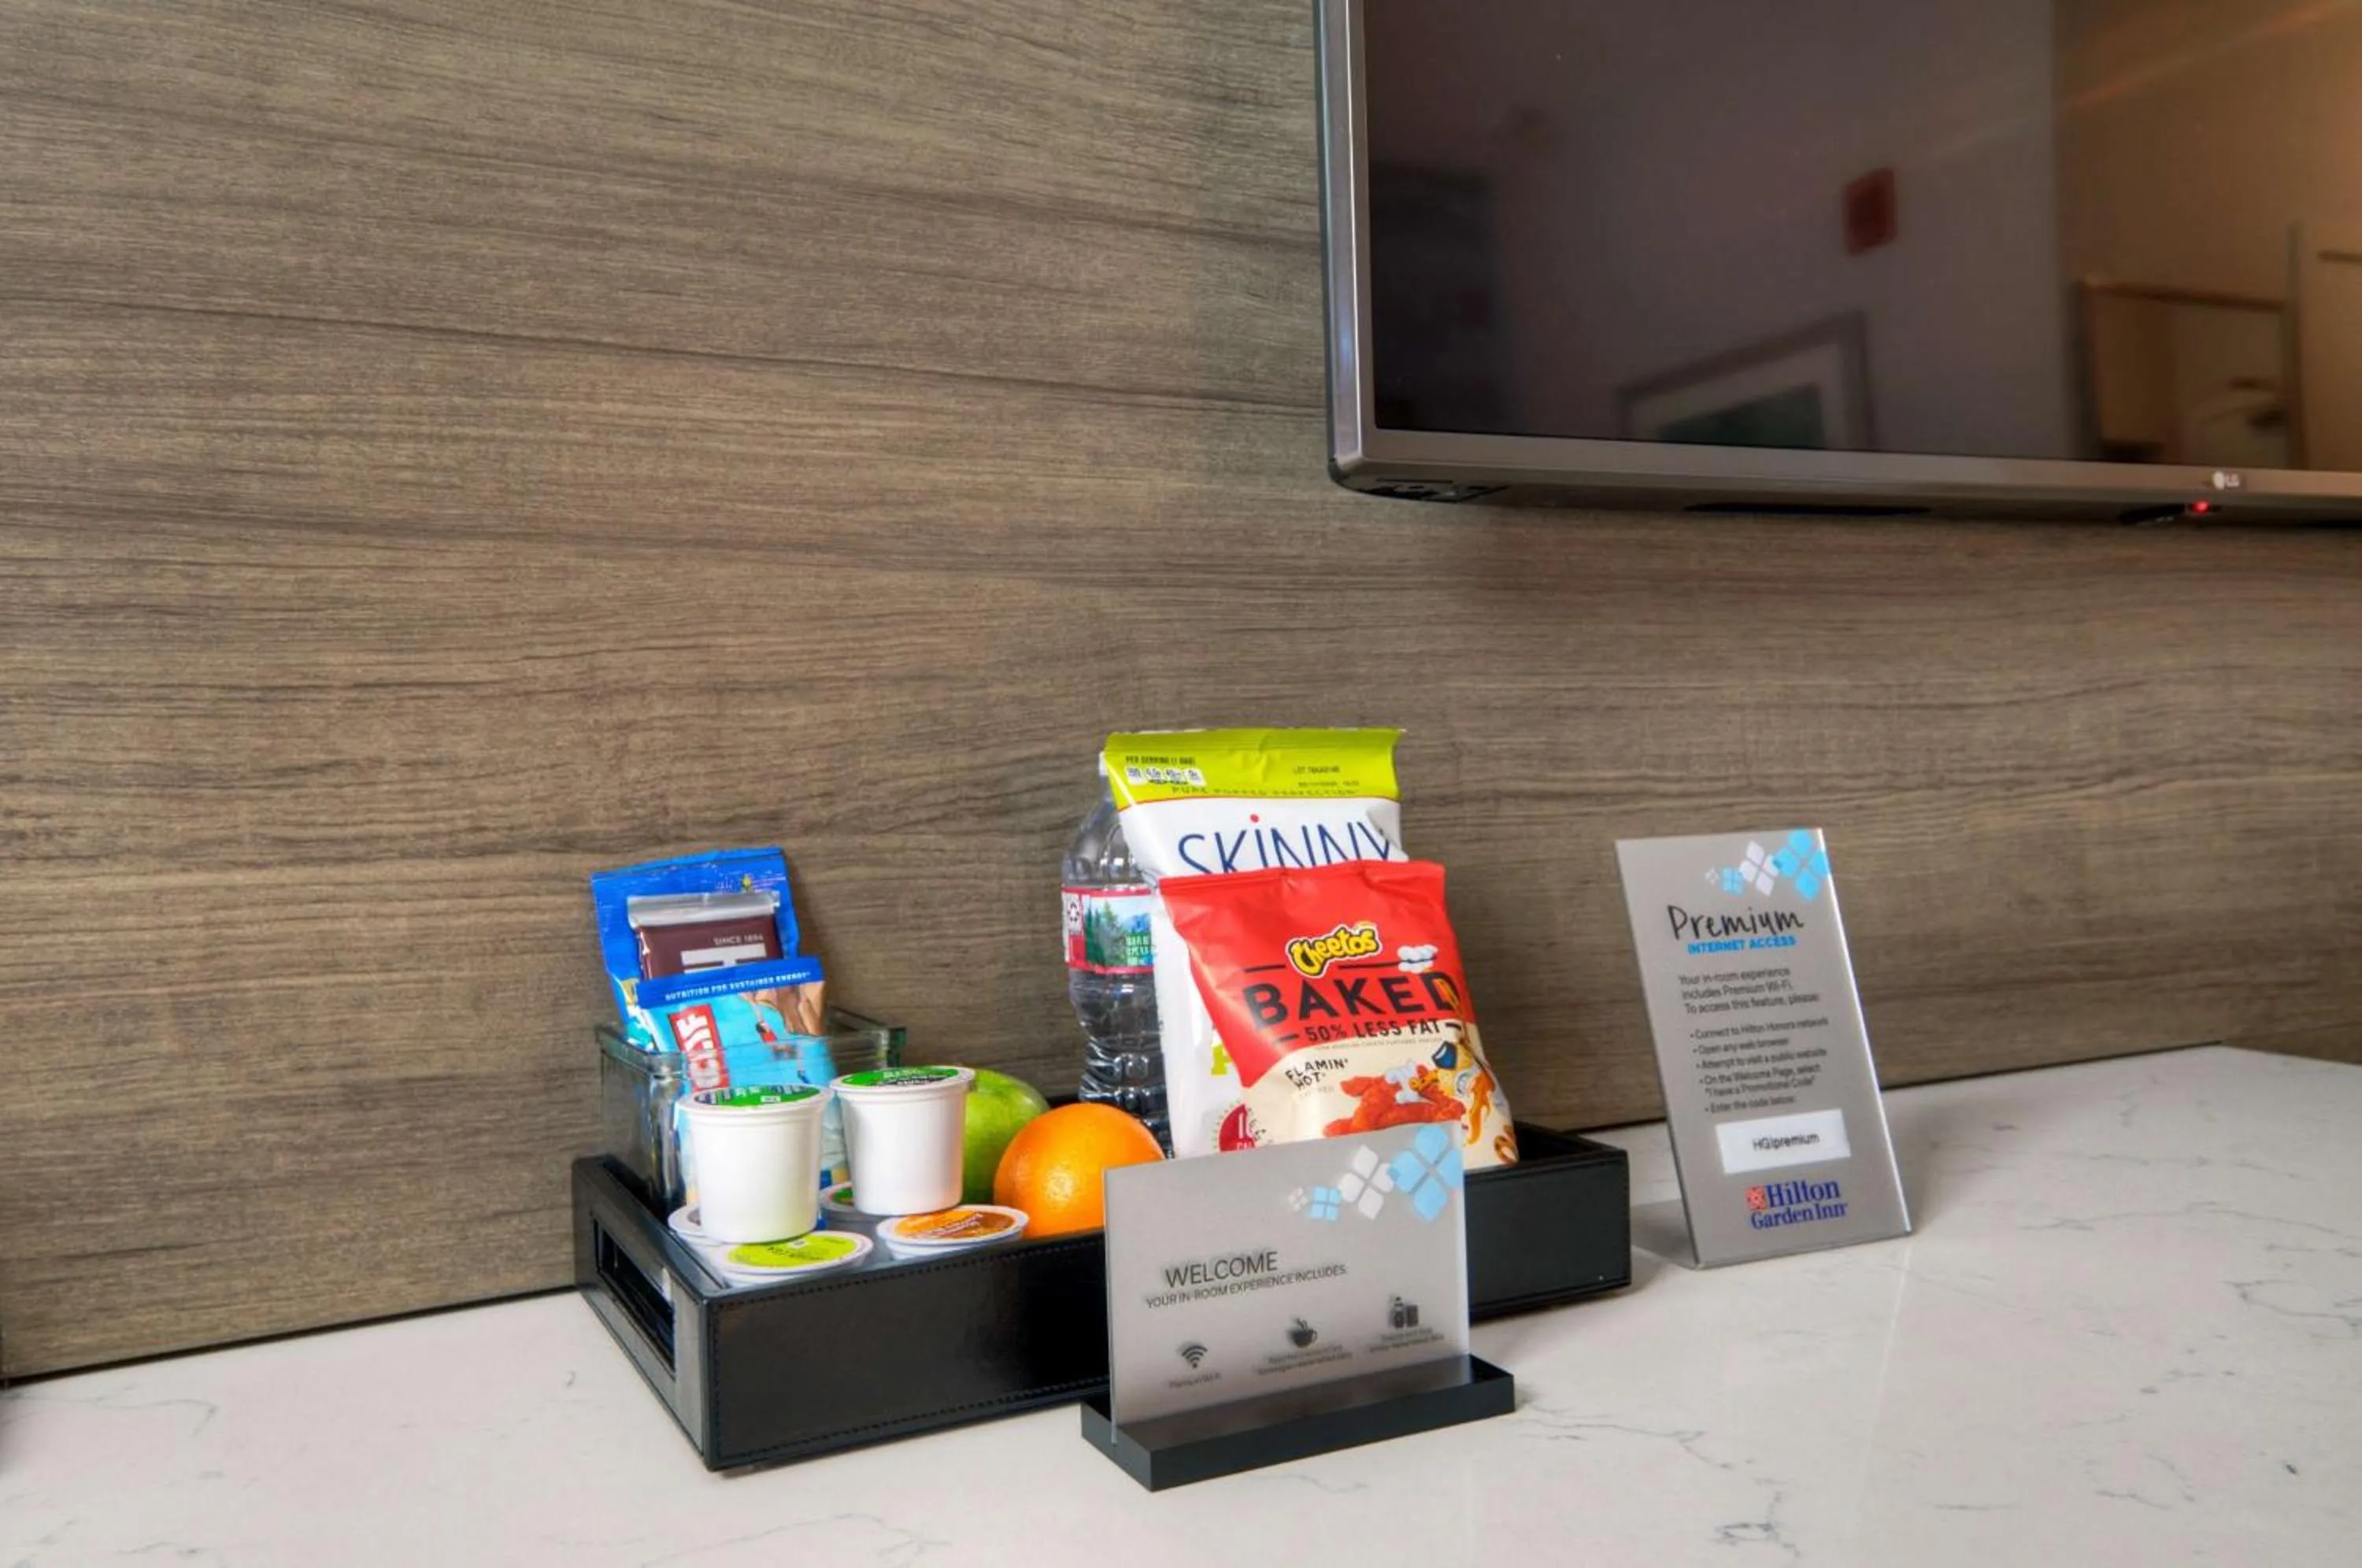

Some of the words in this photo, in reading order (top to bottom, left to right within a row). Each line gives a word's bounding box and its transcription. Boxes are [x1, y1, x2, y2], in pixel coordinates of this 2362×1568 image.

[1667, 905, 1805, 940] Premium
[713, 935, 742, 945] SINCE
[1287, 923, 1379, 976] Cheetos
[1687, 937, 1746, 955] INTERNET
[1749, 935, 1796, 949] ACCESS
[665, 986, 709, 1001] NUTRITION
[711, 983, 728, 993] FOR
[730, 977, 775, 989] SUSTAINED
[1741, 968, 1790, 982] experience
[1242, 970, 1461, 1030] BAKED
[1722, 984, 1765, 997] Premium
[1304, 1023, 1347, 1042] 50%
[1353, 1019, 1403, 1039] LESS
[1405, 1017, 1442, 1035] FAT
[676, 1012, 723, 1089] CLIF
[1766, 1179, 1841, 1208] Hilton
[1749, 1204, 1815, 1230] Garden
[1815, 1203, 1847, 1221] Inn
[1164, 1251, 1279, 1289] WELCOME
[1146, 1292, 1178, 1309] YOUR
[1178, 1285, 1228, 1304] IN-ROOM
[1228, 1274, 1295, 1295] EXPERIENCE
